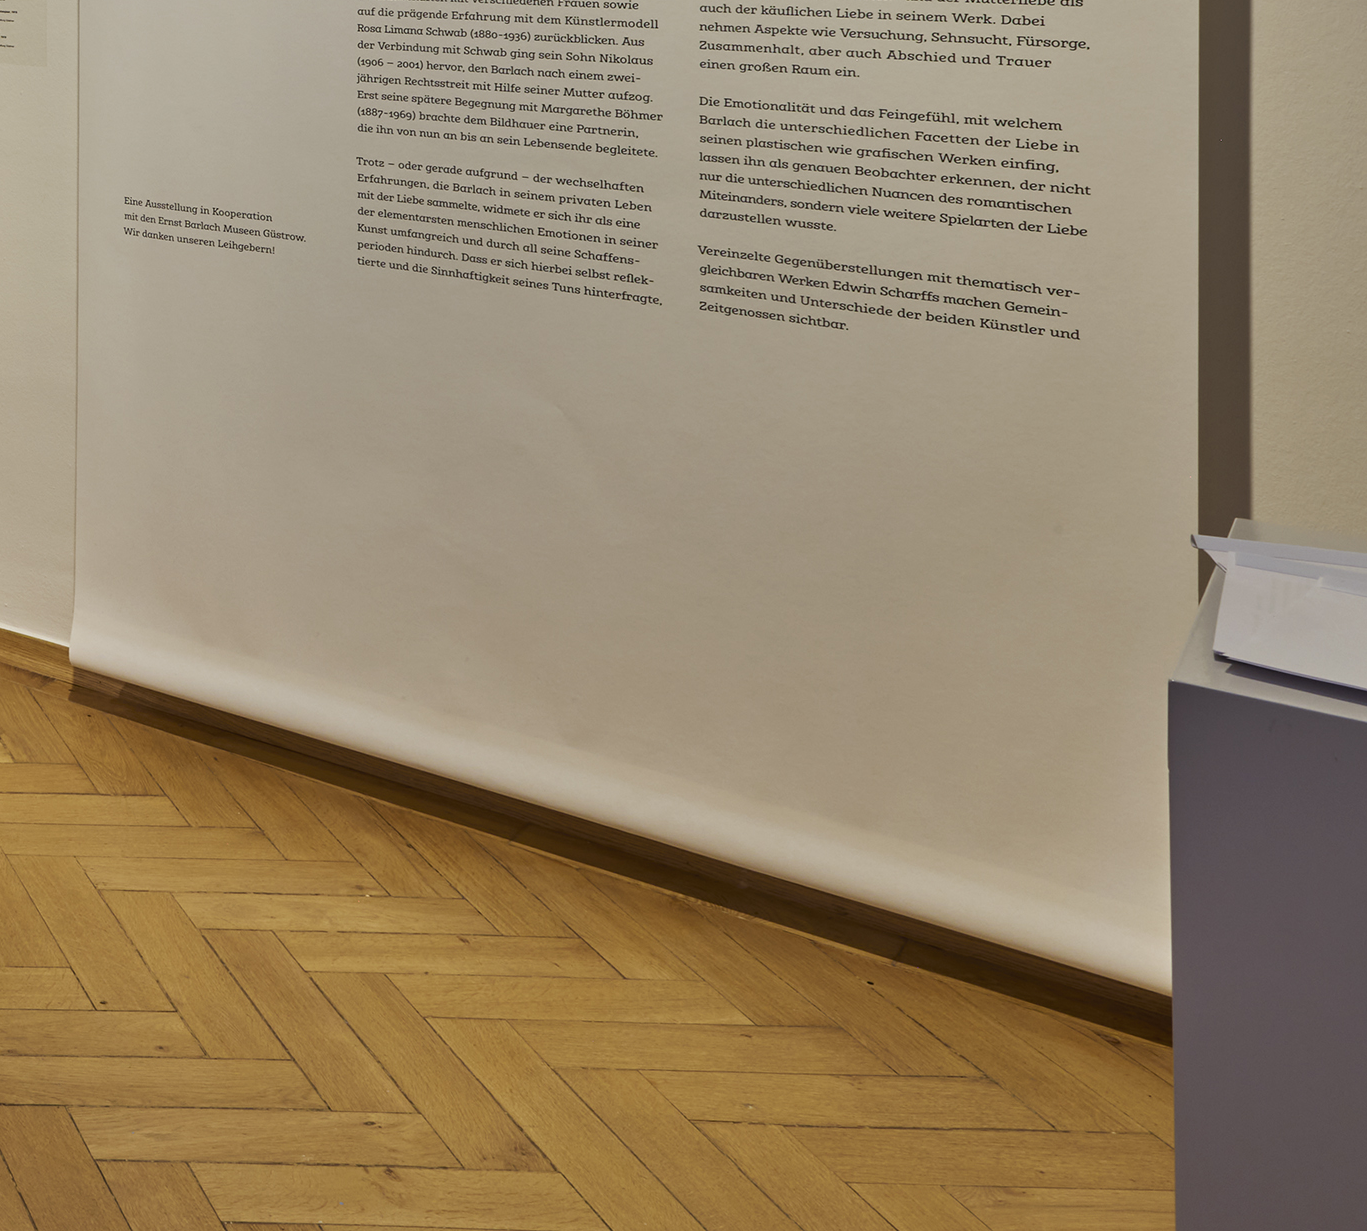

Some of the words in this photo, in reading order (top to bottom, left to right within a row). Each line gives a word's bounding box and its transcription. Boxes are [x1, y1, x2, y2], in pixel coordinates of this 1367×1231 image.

[357, 24, 381, 33] Rosa
[385, 25, 423, 35] Limana
[426, 27, 467, 37] Schwab
[470, 29, 531, 42] (1880-1936)
[534, 33, 618, 45] zurückblicken.
[621, 37, 645, 47] Aus
[699, 22, 751, 33] nehmen
[754, 25, 807, 37] Aspekte
[811, 27, 836, 37] wie
[700, 59, 735, 70] einen
[739, 62, 787, 73] großen
[792, 65, 831, 75] Raum
[835, 67, 859, 77] ein.
[699, 97, 720, 107] Die
[724, 98, 815, 113] Emotionalität
[819, 106, 845, 115] und
[850, 107, 874, 117] das
[964, 115, 989, 125] mit
[993, 118, 1062, 131] welchem
[124, 197, 143, 206] Eine
[145, 199, 197, 215] Ausstellung
[200, 206, 209, 215] in
[213, 207, 272, 222] Kooperation
[700, 208, 781, 225] darzustellen
[785, 219, 836, 231] wusste.
[123, 227, 140, 237] Wir
[142, 230, 174, 241] danken
[177, 236, 215, 247] unseren
[218, 239, 275, 254] Leihgebern!
[124, 213, 138, 221] mit
[140, 214, 156, 224] den
[158, 217, 183, 227] Ernst
[184, 220, 221, 232] Barlach
[223, 225, 261, 237] Museen
[263, 229, 307, 242] Güstrow.
[357, 257, 386, 268] tierte
[389, 262, 409, 271] und
[412, 263, 428, 273] die
[431, 266, 509, 285] Sinnhaftigkeit
[513, 278, 549, 290] seines
[552, 282, 581, 294] Tuns
[699, 301, 785, 321] Zeitgenossen
[789, 314, 849, 330] sichtbar.
